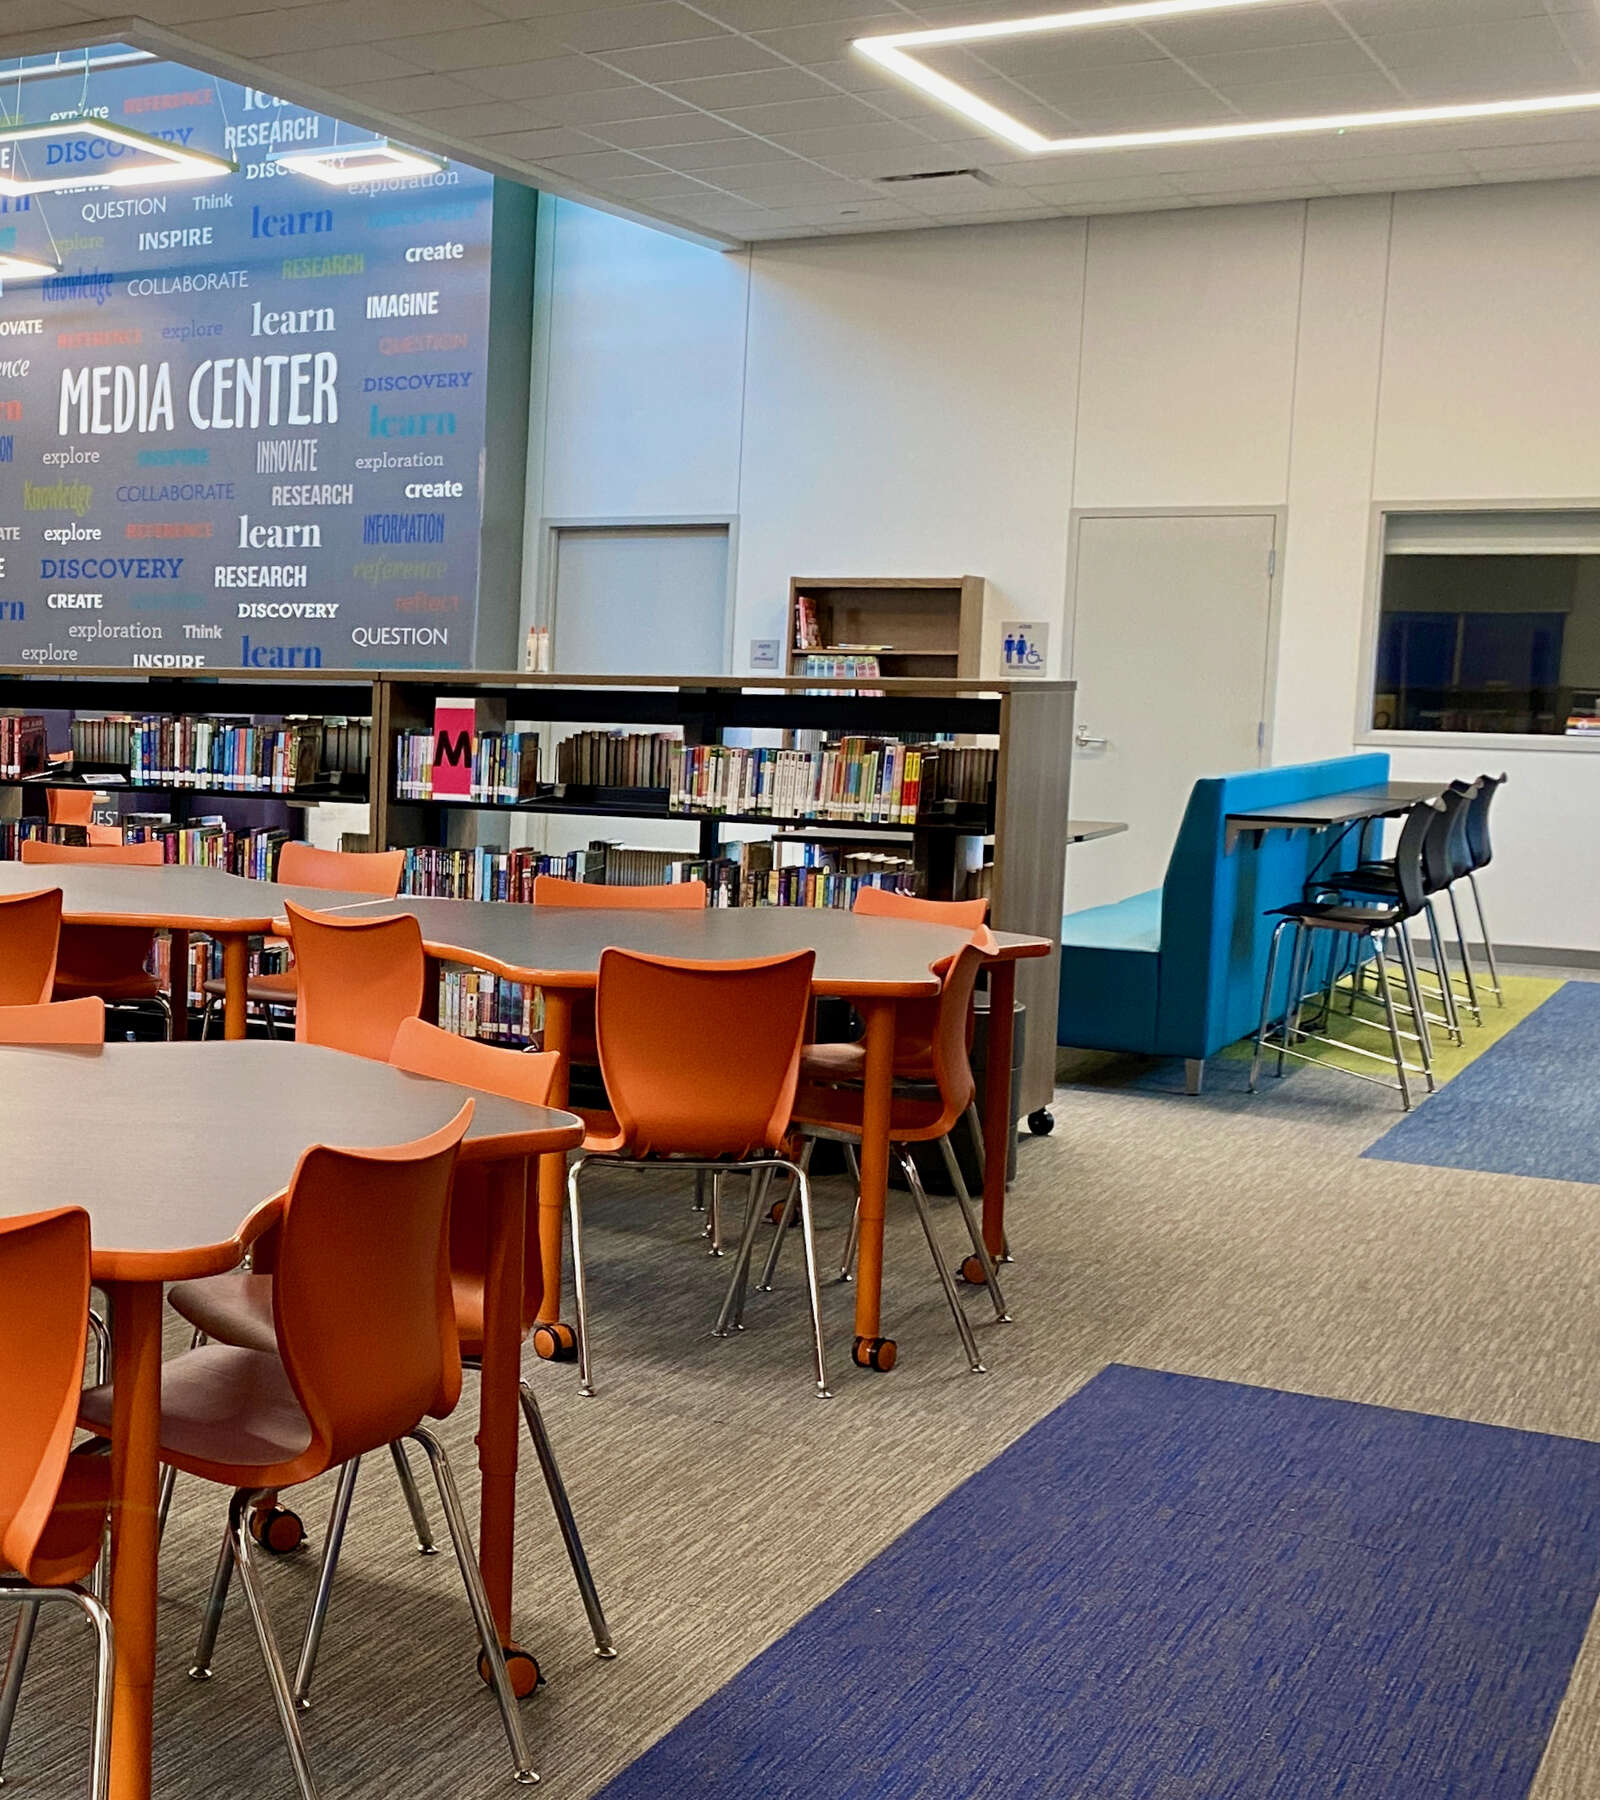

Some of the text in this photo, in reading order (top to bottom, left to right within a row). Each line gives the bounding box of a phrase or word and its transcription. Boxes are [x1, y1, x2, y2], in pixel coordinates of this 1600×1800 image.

[224, 116, 319, 150] RESEARCH
[348, 170, 459, 197] exploration
[82, 197, 166, 222] QUESTION
[192, 193, 233, 211] Think
[251, 204, 333, 239] learn
[138, 227, 213, 250] INSPIRE
[405, 241, 464, 262] create
[282, 253, 364, 279] RESEARCH
[128, 270, 249, 297] COLLABORATE
[366, 291, 439, 319] IMAGINE
[251, 302, 336, 337] learn
[162, 320, 224, 342] explore
[363, 372, 472, 392] DISCOVERY
[59, 352, 338, 436] MEDIA CENTER
[369, 404, 457, 438] learn
[42, 446, 100, 468] explore
[256, 439, 318, 474] INNOVATE
[355, 452, 444, 472] exploration
[116, 483, 235, 502] COLLABORATE
[271, 484, 353, 506] RESEARCH
[405, 480, 463, 499] create
[44, 523, 102, 544] explore
[238, 514, 322, 549] learn
[363, 513, 445, 545] INFORMATION
[40, 558, 184, 579] DISCOVERY
[215, 565, 307, 588] RESEARCH
[47, 593, 103, 609] CREATE
[237, 604, 339, 619] DISCOVERY
[68, 620, 163, 641] exploration
[183, 624, 222, 639] Think
[352, 627, 448, 647] QUESTION
[22, 643, 78, 664] explore
[133, 654, 205, 668] INSPIRE
[242, 635, 322, 668] learn
[433, 730, 471, 768] M
